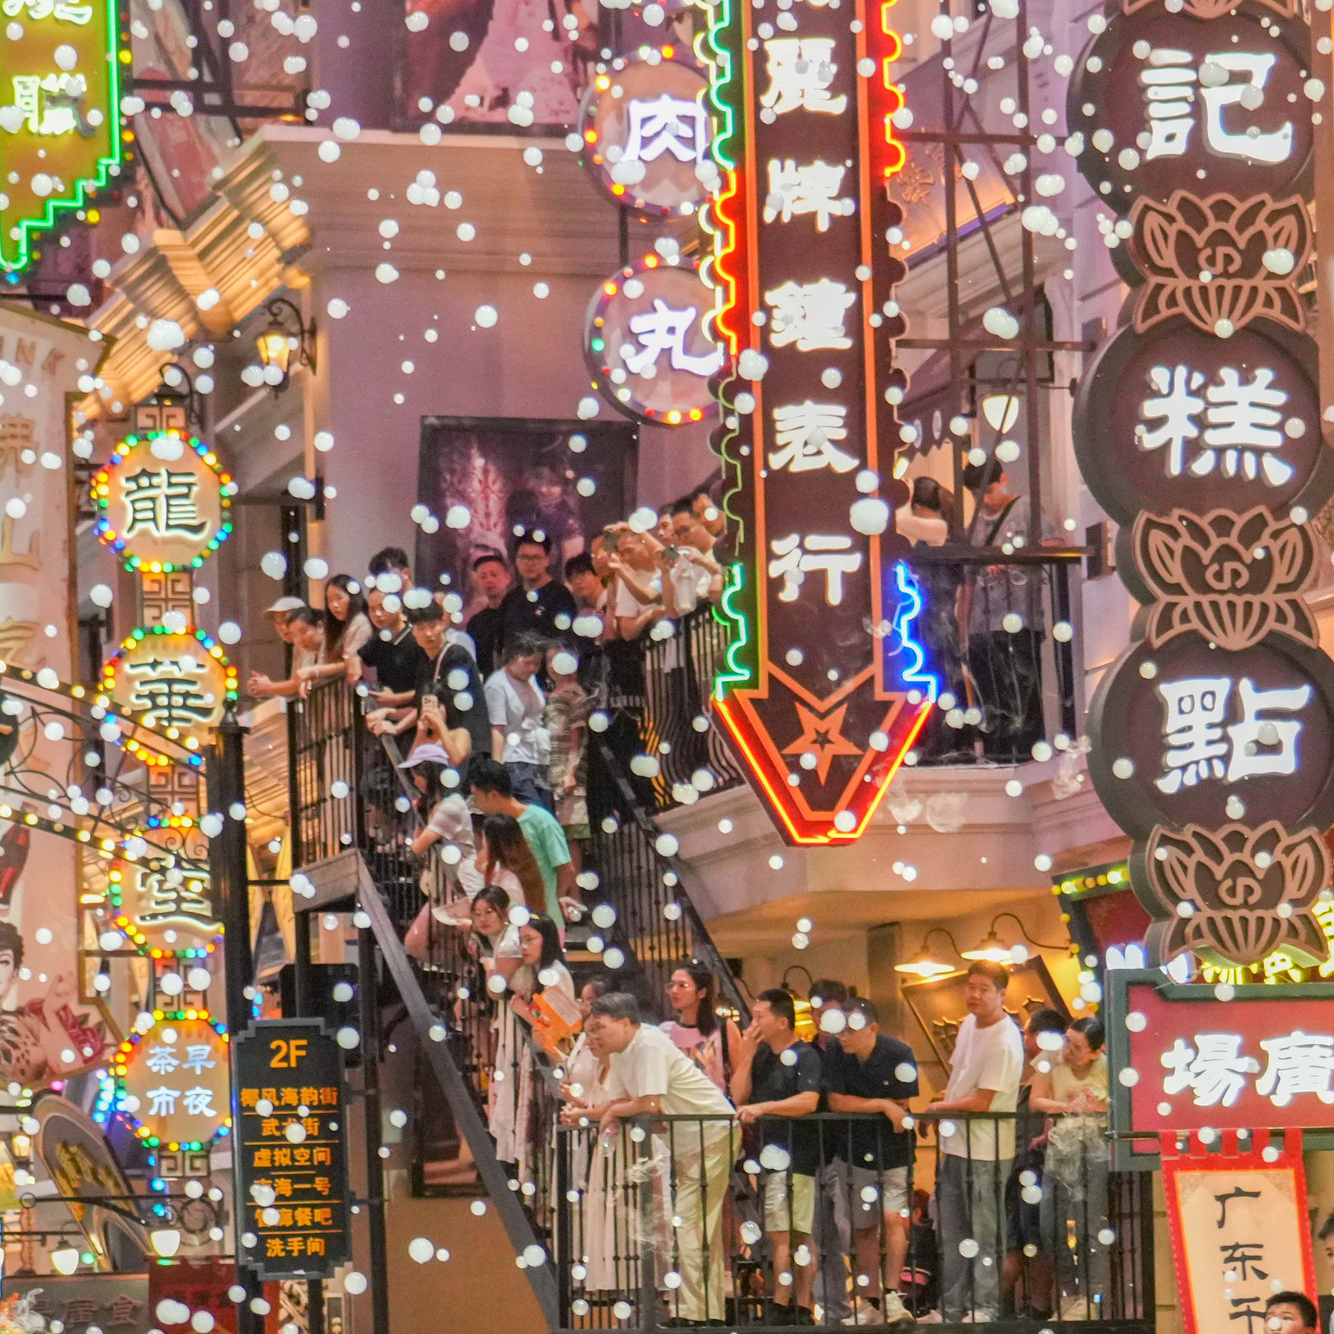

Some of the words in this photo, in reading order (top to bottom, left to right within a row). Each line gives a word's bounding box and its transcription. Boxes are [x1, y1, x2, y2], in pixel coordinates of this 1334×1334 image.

[623, 94, 724, 377] 肉丸
[270, 1039, 308, 1069] 2F
[253, 1147, 331, 1168] 虚拟空间
[267, 1237, 325, 1258] 洗手间
